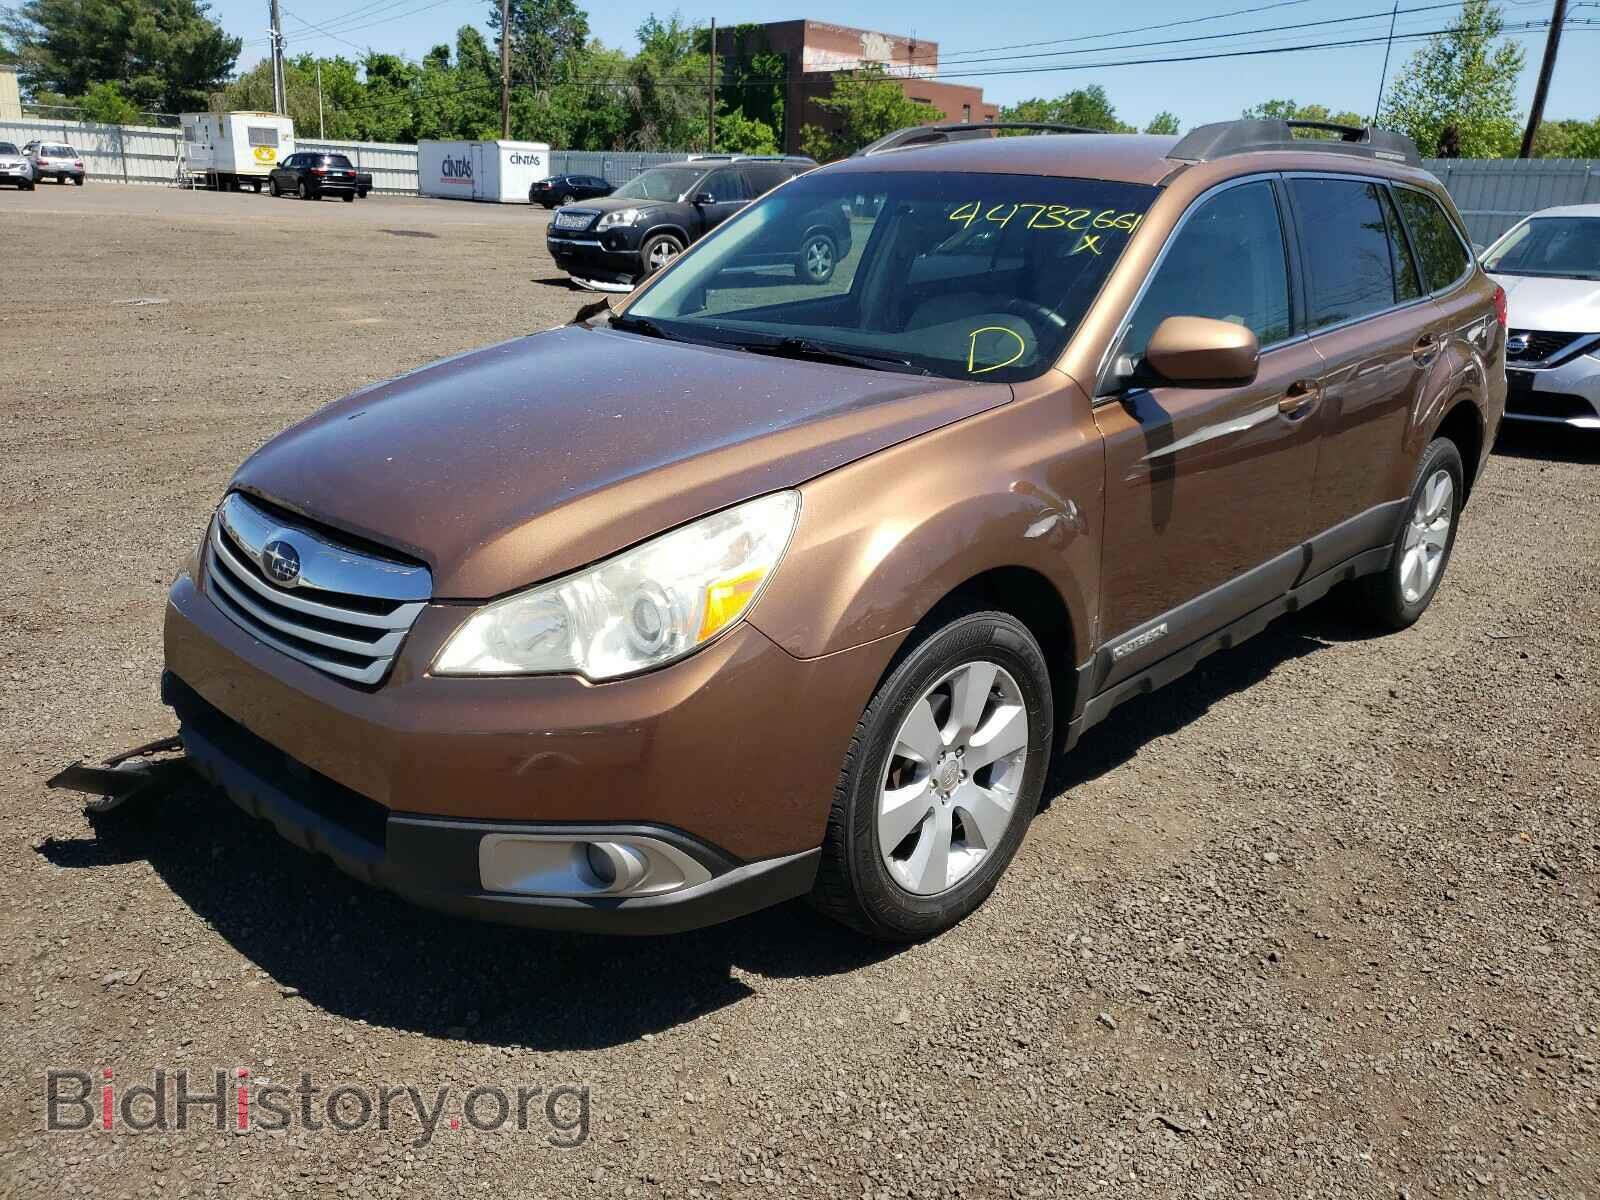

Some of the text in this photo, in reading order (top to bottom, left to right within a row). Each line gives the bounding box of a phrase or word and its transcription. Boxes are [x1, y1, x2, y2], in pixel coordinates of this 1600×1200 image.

[442, 154, 472, 178] CINTAS
[510, 152, 540, 166] CINTAS
[949, 200, 1142, 234] 44732661
[968, 326, 1025, 374] D
